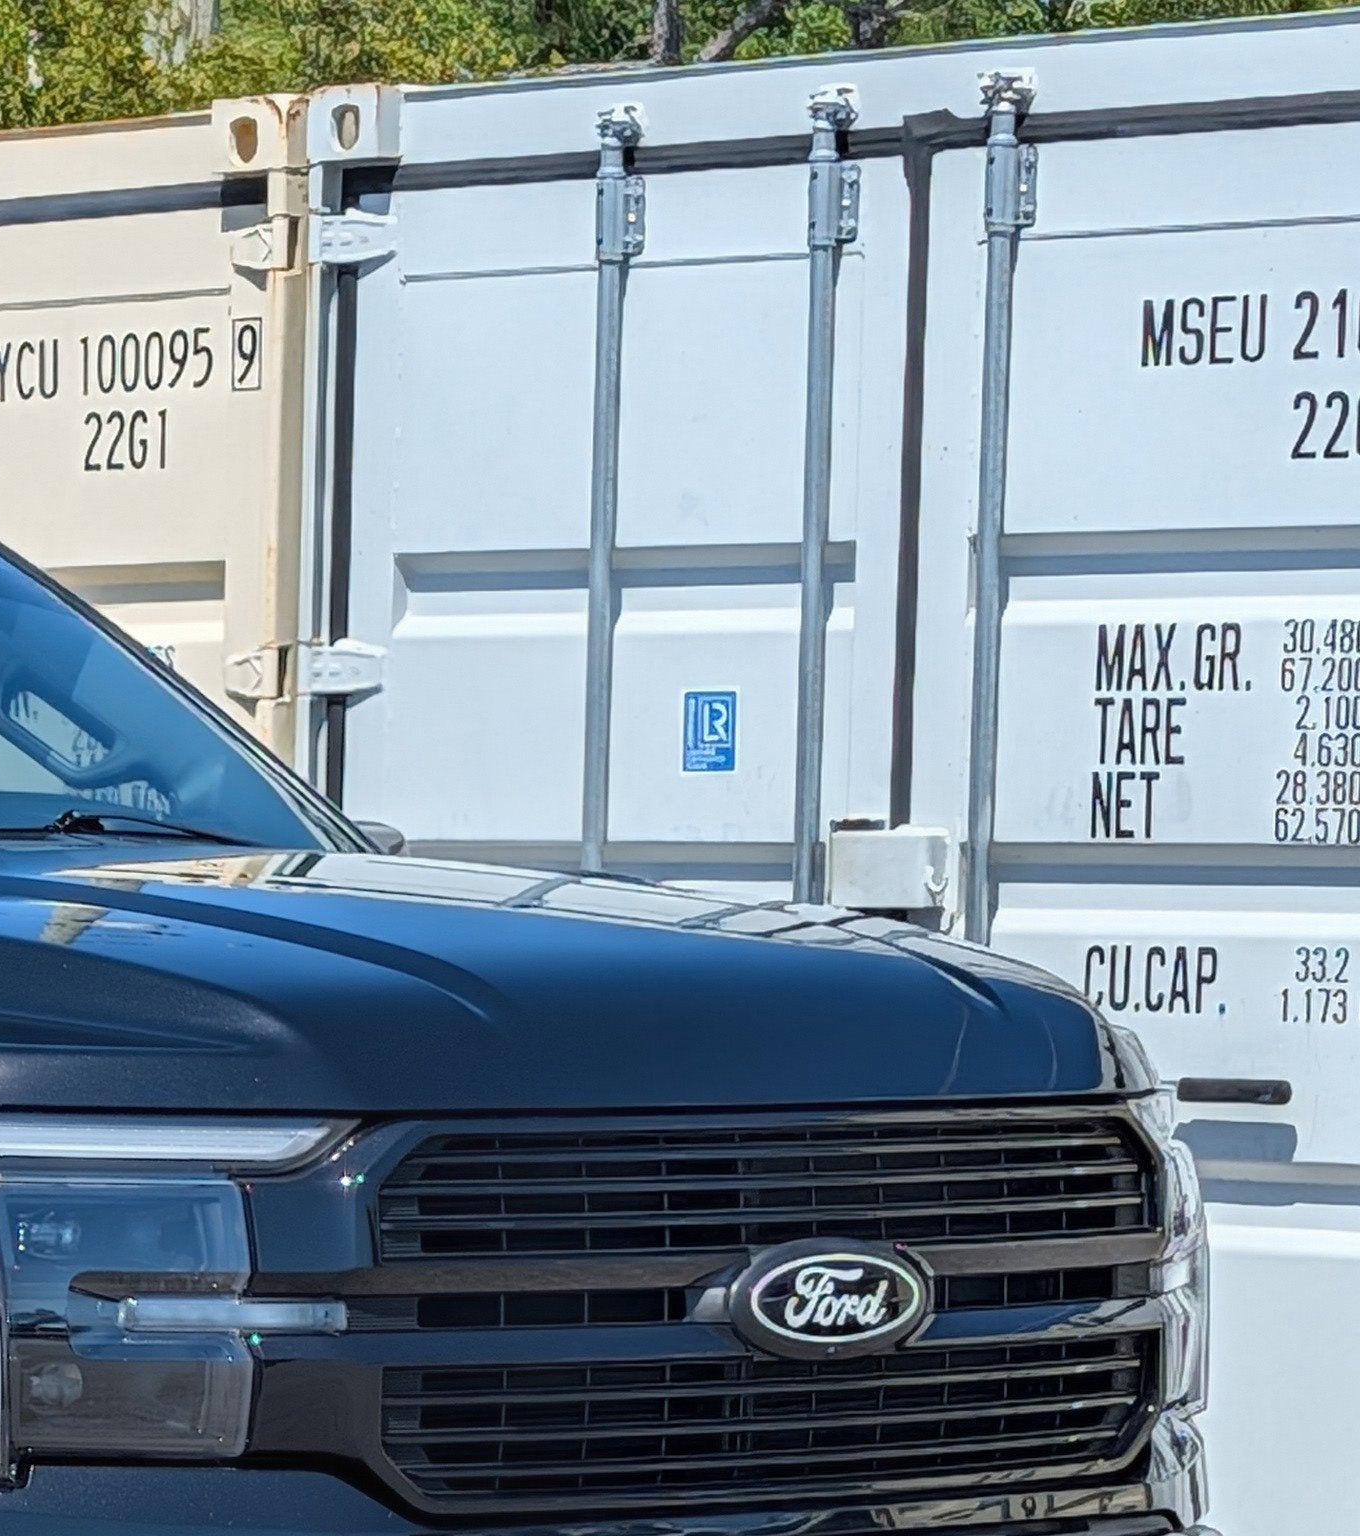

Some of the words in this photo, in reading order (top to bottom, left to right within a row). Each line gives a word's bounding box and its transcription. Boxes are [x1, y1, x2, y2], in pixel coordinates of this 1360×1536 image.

[80, 327, 212, 396] 100095
[237, 323, 258, 384] 9
[1141, 294, 1268, 367] MSEU
[1293, 288, 1360, 361] 21
[83, 409, 167, 471] 22G1
[1290, 391, 1360, 460] 22
[1094, 697, 1187, 766] TARE
[1090, 771, 1160, 839] NET
[1085, 944, 1226, 1016] CU.CAP.
[1294, 946, 1350, 984] 33.2
[784, 1266, 888, 1328] Ford
